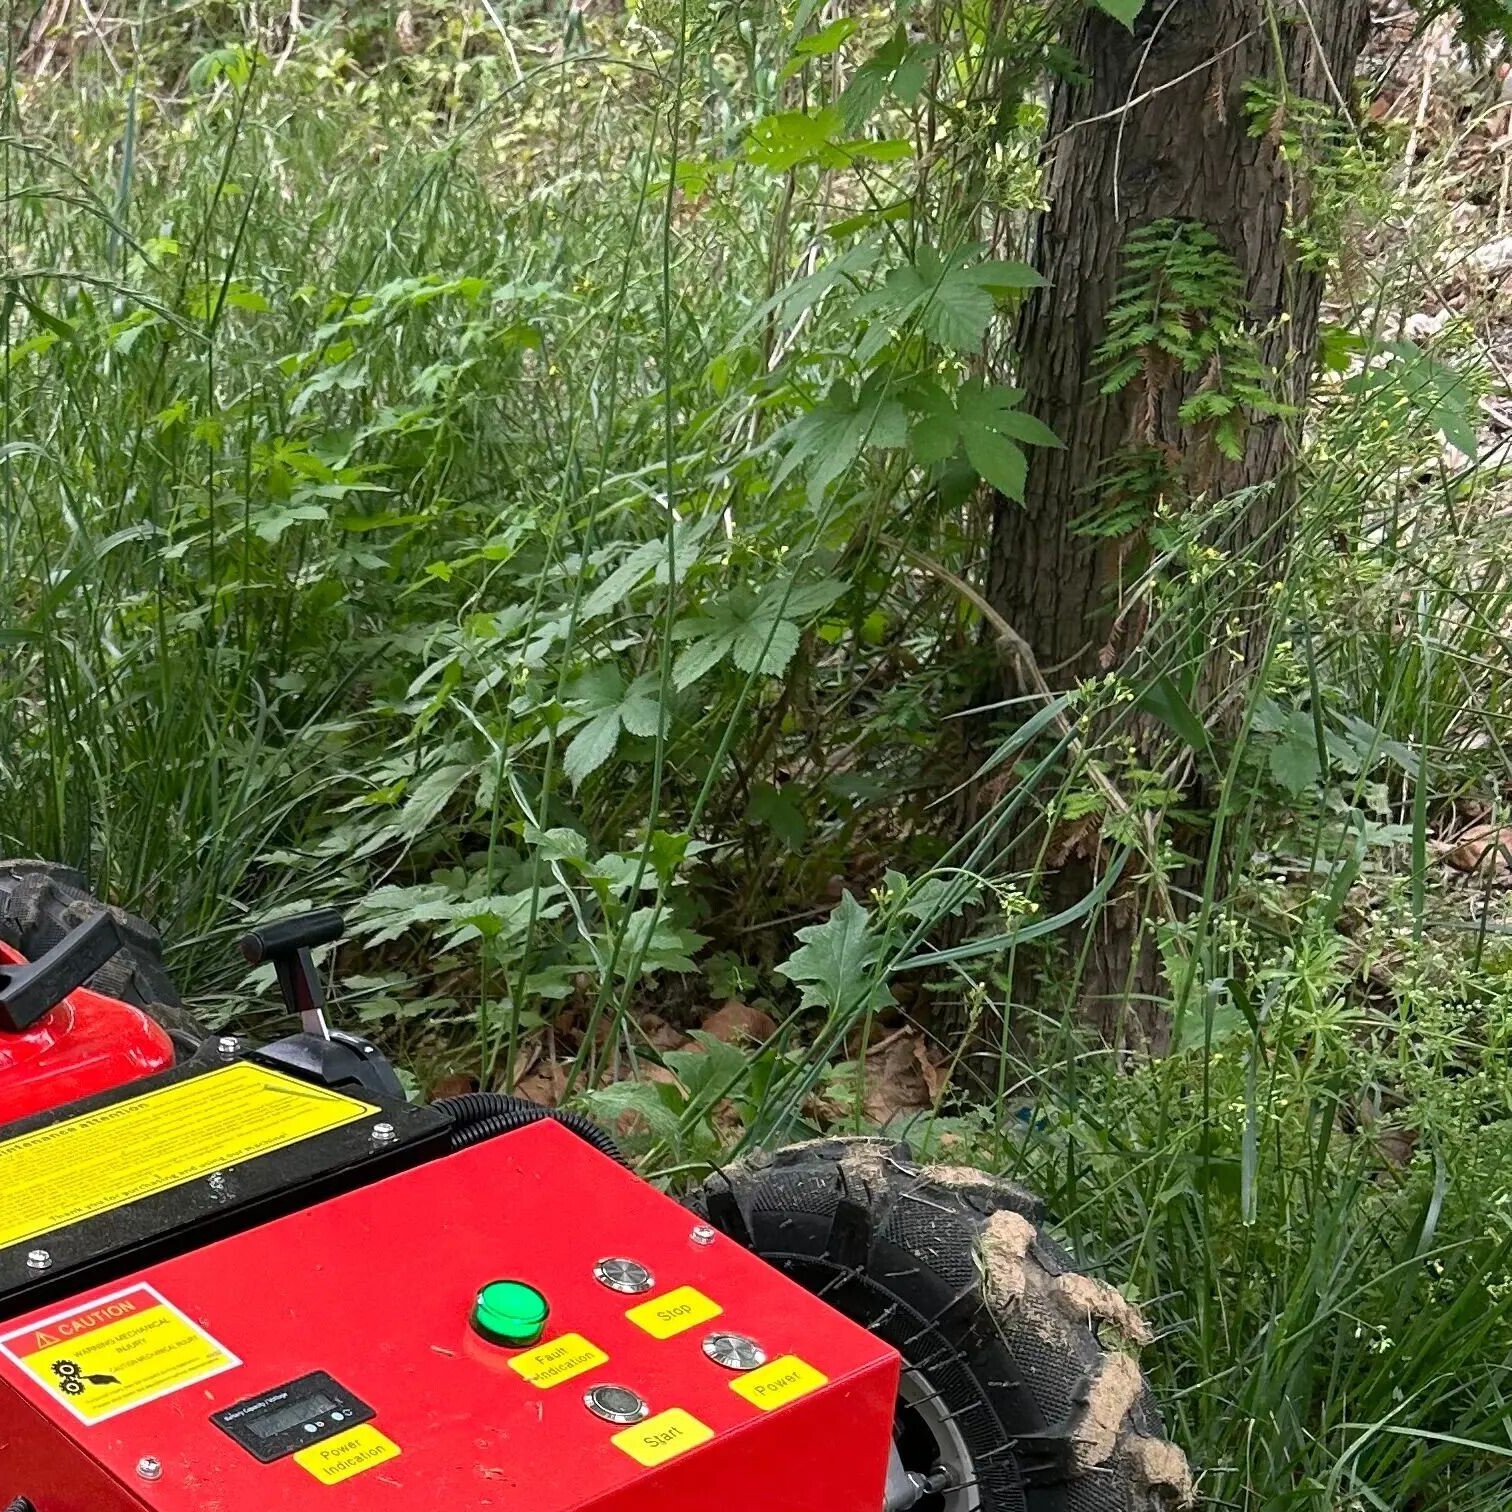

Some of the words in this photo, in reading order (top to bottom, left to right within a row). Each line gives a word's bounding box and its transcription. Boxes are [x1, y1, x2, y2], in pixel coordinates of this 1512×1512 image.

[78, 1102, 149, 1129] attention
[58, 1301, 136, 1335] CAUTION
[657, 1303, 692, 1322] Stop
[534, 1346, 568, 1365] Fault
[537, 1351, 594, 1381] Indication
[754, 1371, 800, 1396] Power
[643, 1426, 683, 1448] Start
[320, 1440, 361, 1460] Power
[322, 1445, 386, 1475] Indication
